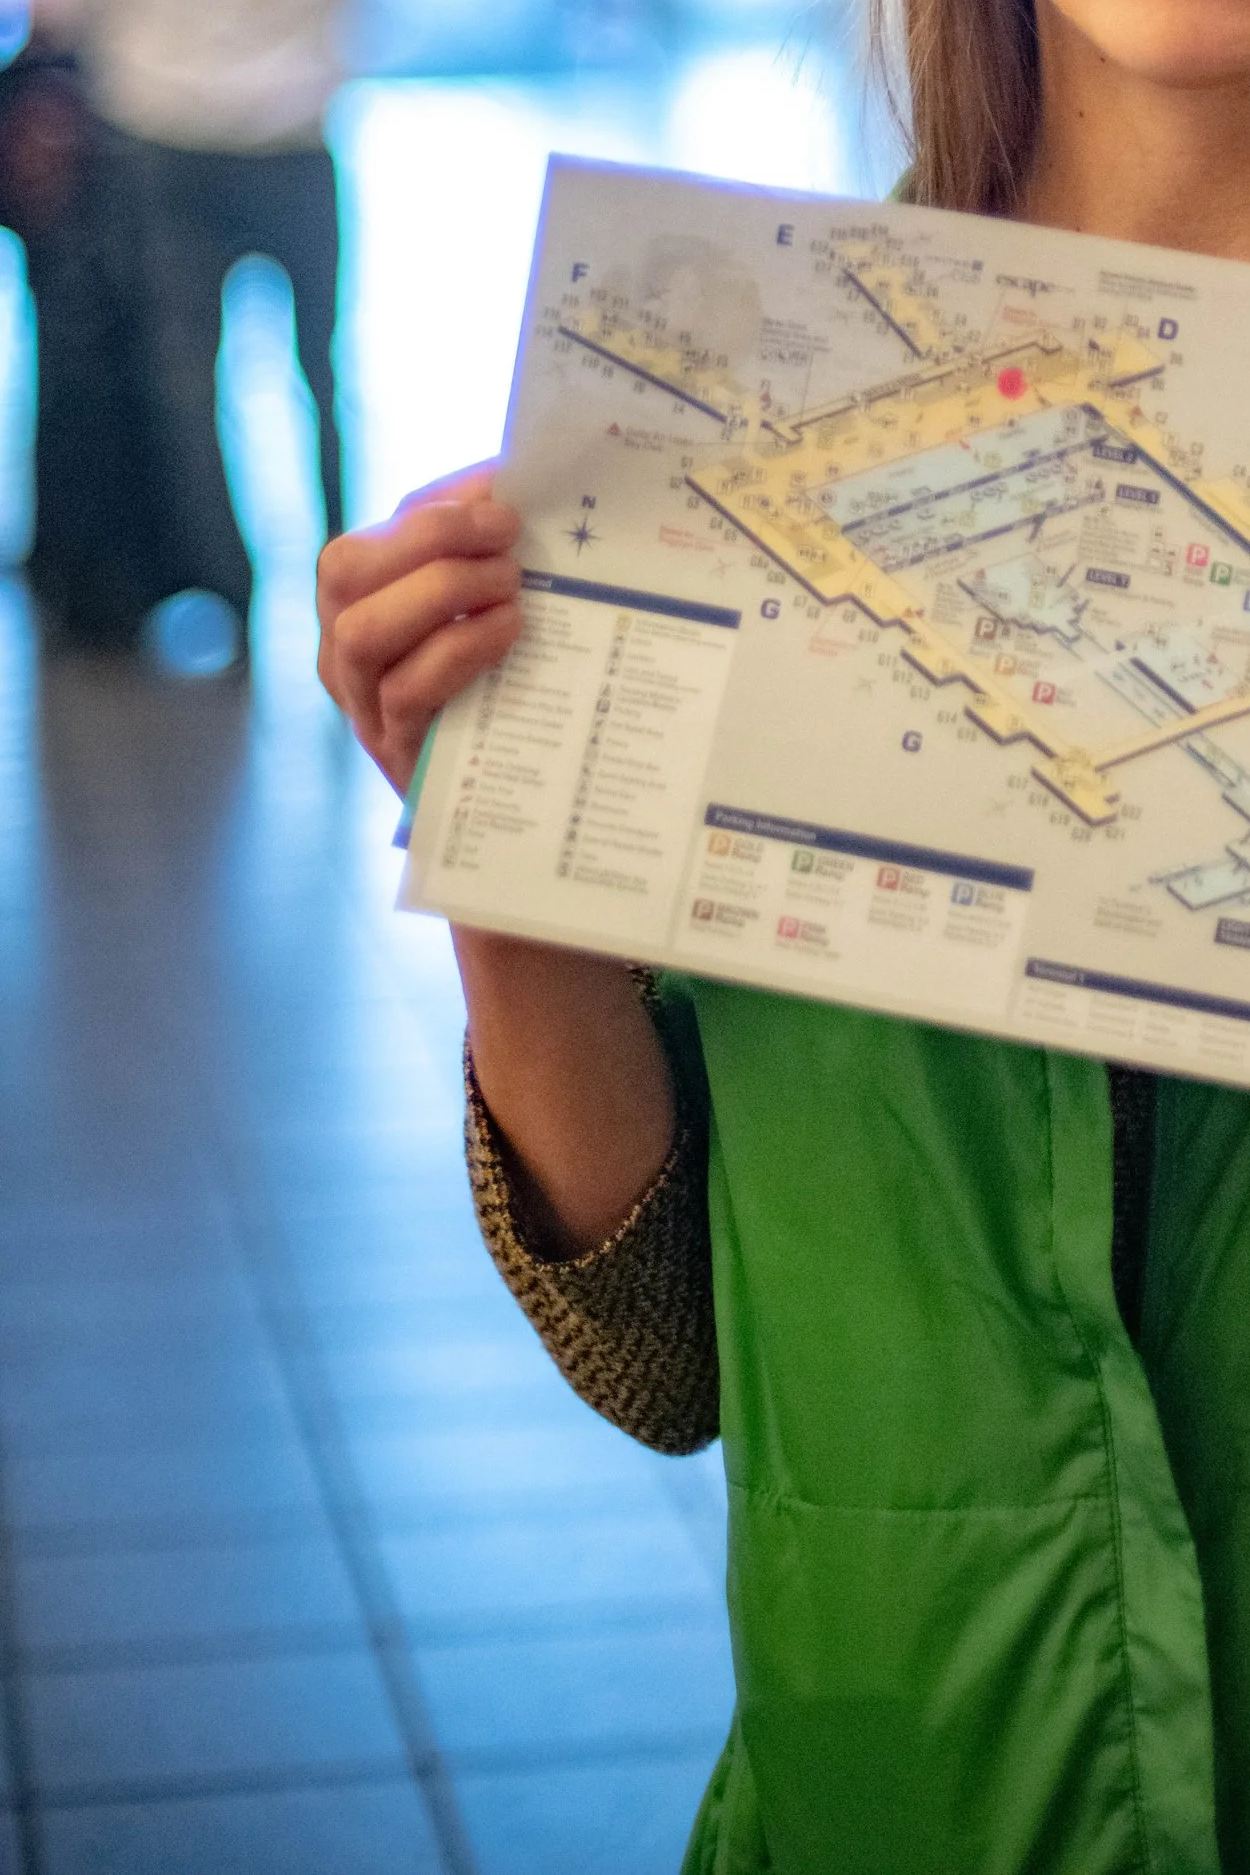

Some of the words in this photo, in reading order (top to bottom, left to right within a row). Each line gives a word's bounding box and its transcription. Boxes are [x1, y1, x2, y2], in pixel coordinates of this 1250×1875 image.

[776, 224, 795, 246] E
[571, 262, 590, 283] F
[1157, 317, 1179, 340] D
[760, 598, 781, 620] G
[902, 730, 923, 753] G
[715, 811, 755, 828] Parking
[756, 819, 817, 841] Information
